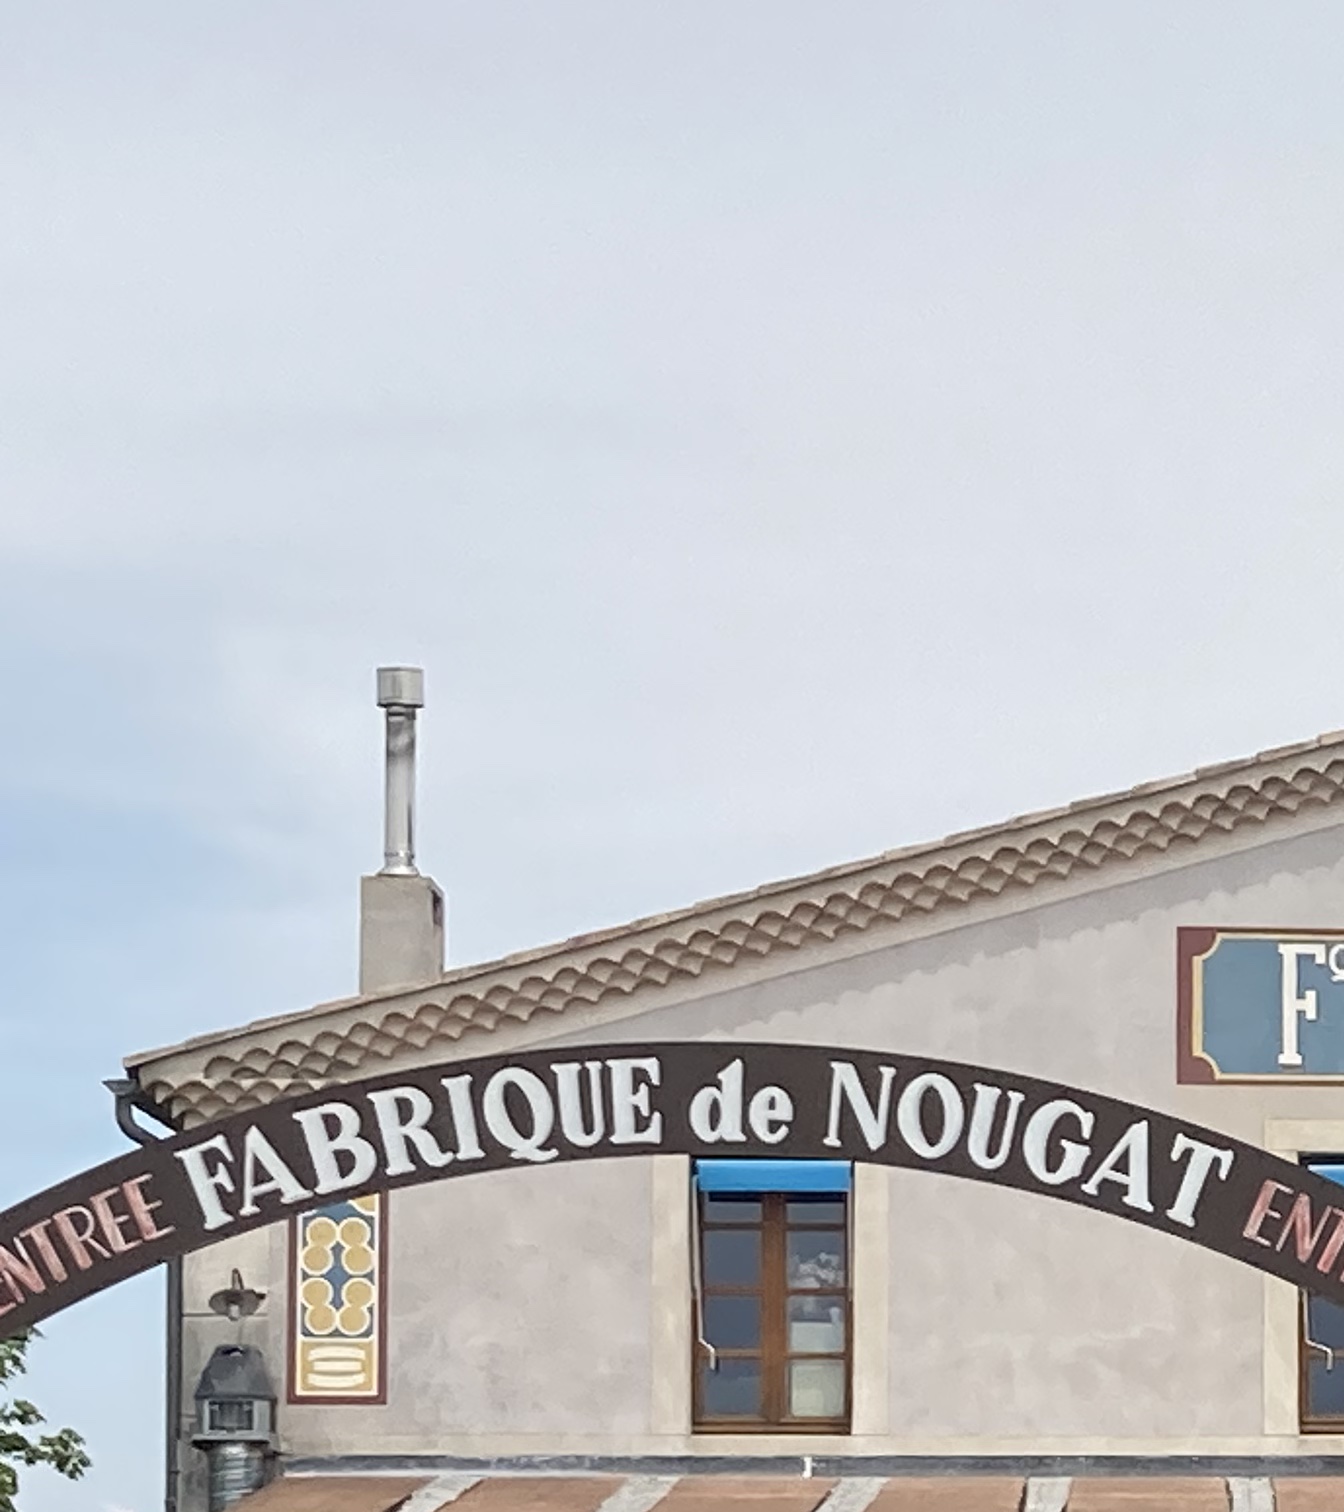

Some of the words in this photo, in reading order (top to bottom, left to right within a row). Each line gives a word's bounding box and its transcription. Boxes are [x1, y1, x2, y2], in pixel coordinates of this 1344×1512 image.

[173, 1057, 661, 1231] FABRIQUE
[690, 1058, 793, 1144] de
[823, 1061, 1234, 1228] NOUGAT
